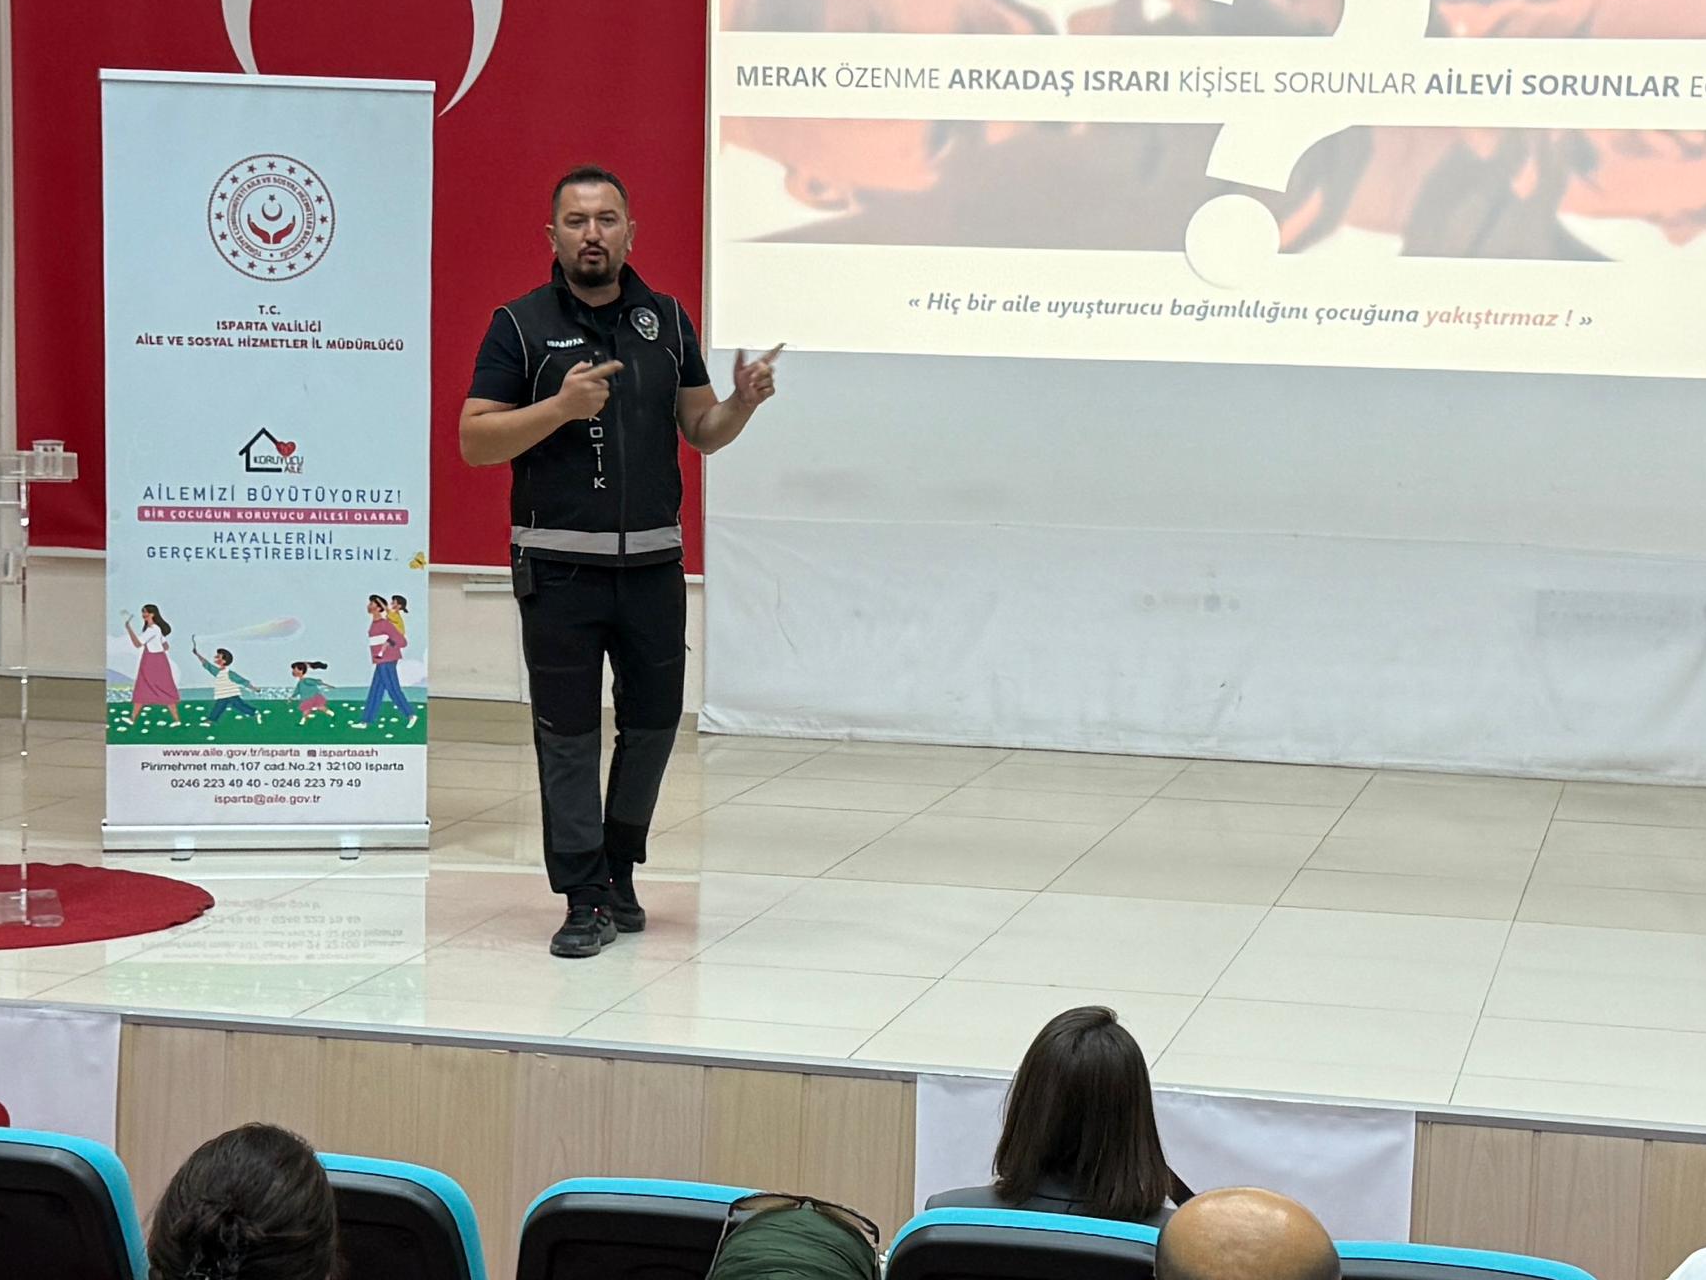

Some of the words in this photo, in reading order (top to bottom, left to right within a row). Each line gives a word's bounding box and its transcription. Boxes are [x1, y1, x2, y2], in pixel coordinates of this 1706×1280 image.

[736, 65, 827, 87] MERAK
[835, 62, 940, 89] ÖZENME
[948, 68, 1074, 97] ARKADAŞ
[1084, 70, 1169, 92] ISRARI
[1179, 66, 1265, 98] KİŞİSEL
[1273, 72, 1416, 94] SORUNLAR
[1425, 67, 1512, 95] AİLEVİ
[1522, 73, 1680, 98] SORUNLAR
[258, 304, 281, 316] T.C.
[927, 292, 961, 315] Hiç
[967, 293, 997, 311] bir
[1002, 294, 1041, 313] aile
[1047, 298, 1163, 319] uyuşturucu
[1170, 298, 1308, 323] bağımlılığını
[1315, 303, 1419, 326] çocuğuna
[1423, 306, 1559, 329] yakıştırmaz
[216, 320, 268, 332] ISPARTA
[271, 319, 322, 333] VALİLİĞİ
[135, 332, 164, 346] AİLE
[168, 335, 184, 346] VE
[187, 335, 234, 348] SOSYAL
[238, 333, 309, 350] HİZMETLER
[312, 336, 323, 350] İL
[326, 337, 404, 352] MÜDÜRLÜĞÜ
[143, 483, 235, 502] AİLEMİZİ
[247, 485, 402, 503] BÜYÜTÜYORUZ!
[144, 506, 165, 519] BİR
[170, 507, 231, 521] ÇOCUĞUN
[237, 509, 305, 521] KORUYUCU
[310, 509, 349, 522] AİLESİ
[355, 512, 403, 522] OLARAK
[214, 529, 333, 545] HAYALLERİNİ
[141, 761, 208, 772] Pirimehmet
[326, 761, 362, 772] 32100
[365, 761, 405, 774] Isparta
[171, 778, 200, 789] 0246
[203, 778, 226, 789] 223
[246, 778, 262, 789] 40
[272, 778, 301, 789] 0246
[304, 778, 327, 789] 223
[329, 778, 343, 789] 79
[214, 794, 321, 806] isparta@aile.gov.tr
